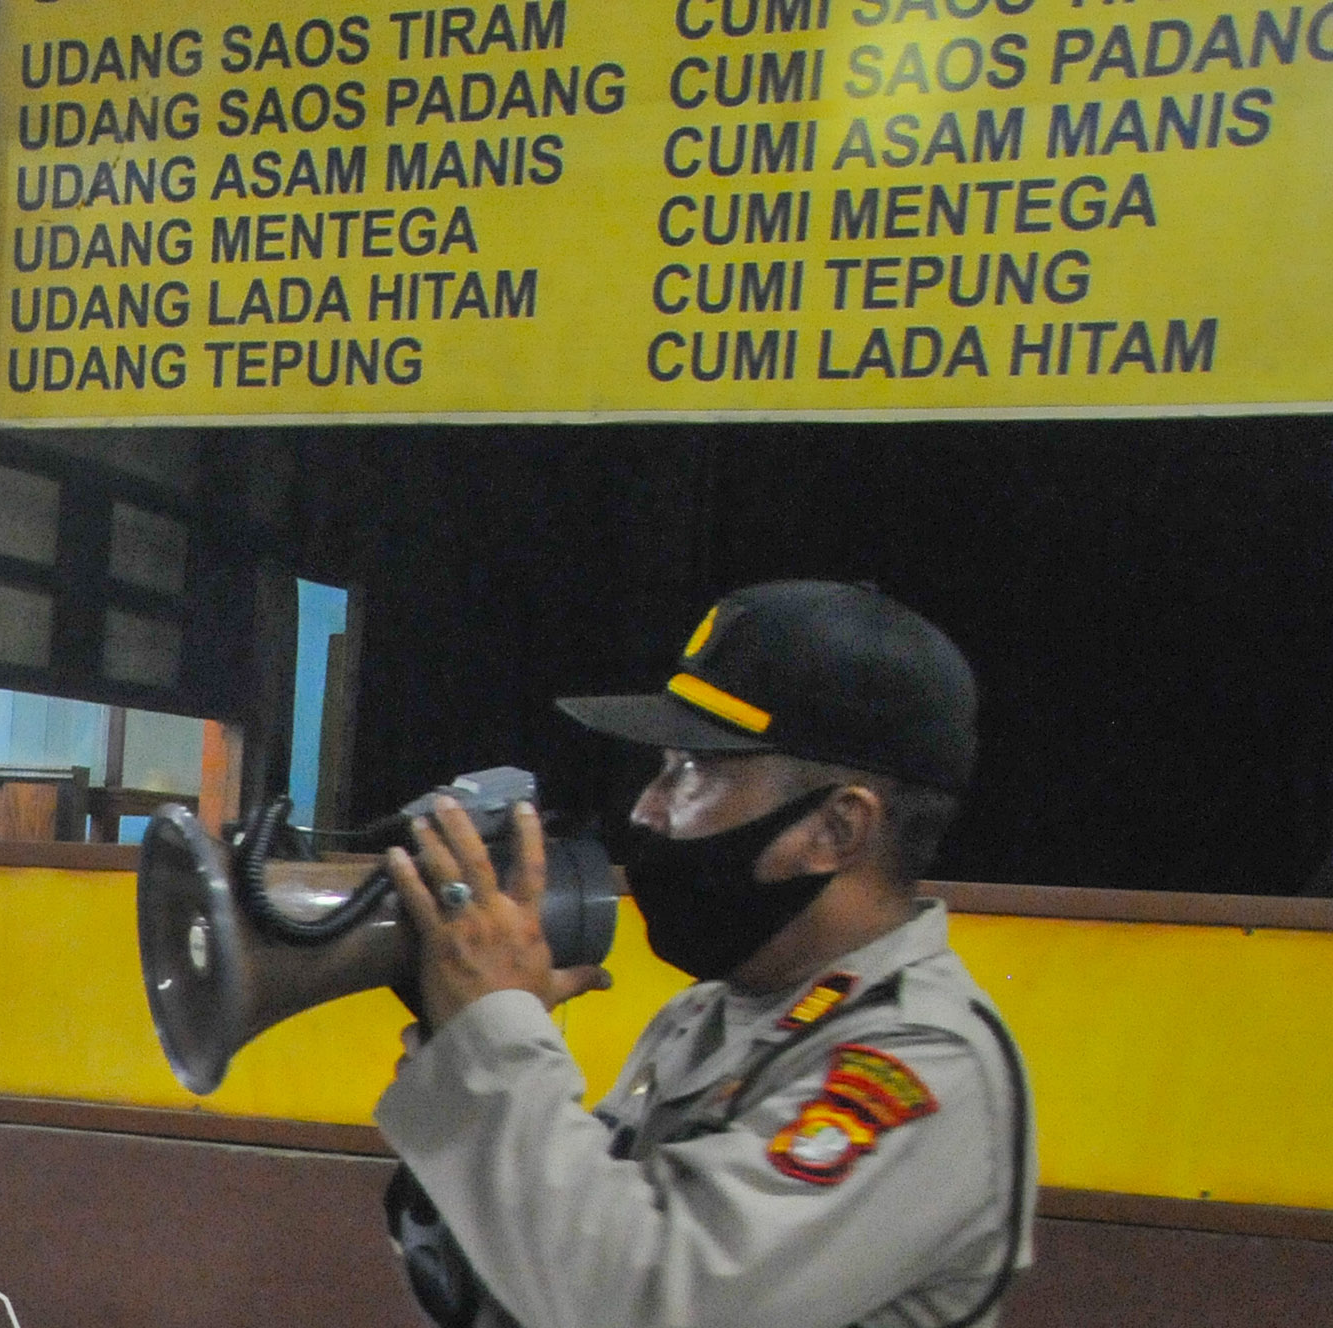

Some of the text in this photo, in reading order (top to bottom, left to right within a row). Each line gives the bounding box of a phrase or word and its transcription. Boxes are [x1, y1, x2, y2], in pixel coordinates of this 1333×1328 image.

[21, 0, 568, 89] UDANG SAOS TIRAM
[675, 0, 831, 40] CUMI
[19, 61, 627, 150] UDANG SAOS PADANG
[669, 49, 825, 110] CUMI
[842, 32, 1028, 100] SAOS
[663, 87, 1274, 179] CUMI ASAM MANIS
[16, 133, 565, 211] UDANG ASAM MANIS
[14, 205, 479, 272] UDANG MENTEGA
[657, 172, 1158, 247] CUMI MENTEGA
[10, 268, 539, 333] UDANG LADA HITAM
[652, 248, 1092, 315] CUMI TEPUNG
[8, 336, 423, 393] UDANG TEPUNG
[647, 317, 1220, 383] CUMI LADA HITAM
